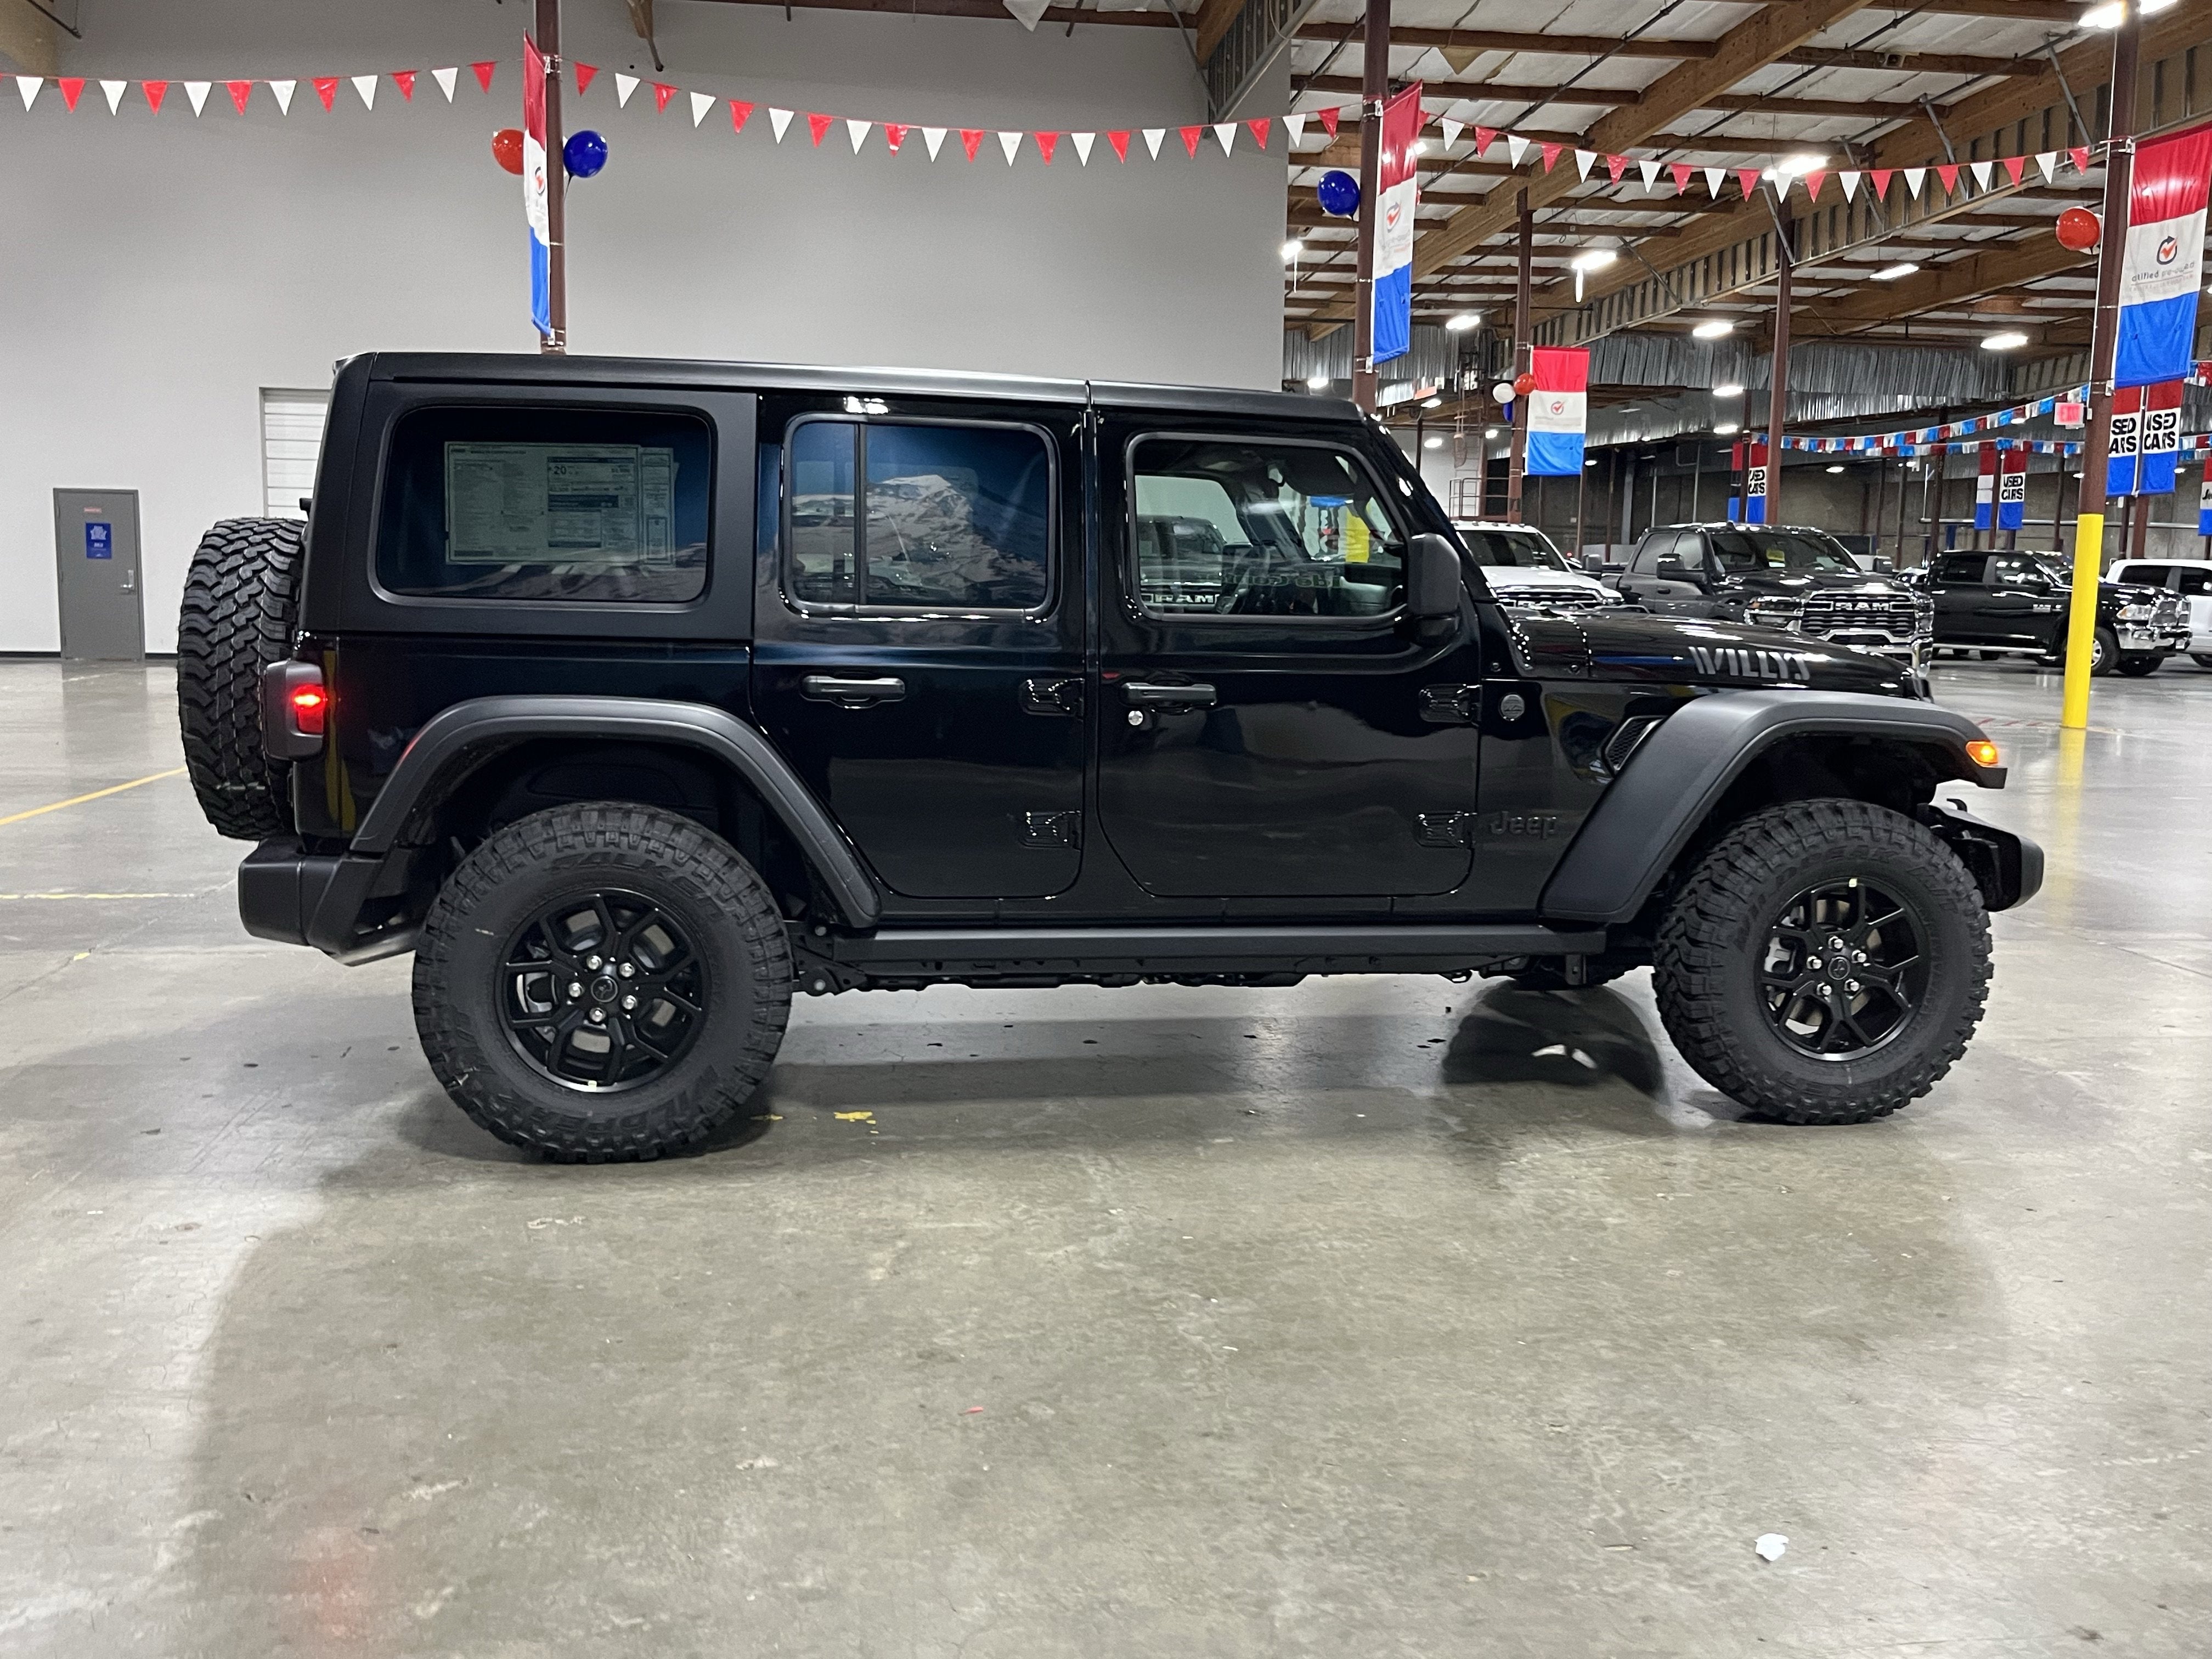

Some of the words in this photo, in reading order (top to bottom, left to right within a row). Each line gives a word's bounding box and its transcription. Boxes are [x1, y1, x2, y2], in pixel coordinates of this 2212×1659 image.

[2111, 417, 2137, 435] SED
[2109, 436, 2137, 454] ARS
[554, 465, 566, 475] 20
[2003, 475, 2023, 488] USED
[1155, 594, 1214, 603] RAM
[1835, 602, 1889, 611] RAM
[1688, 646, 1810, 680] WILLYS
[1491, 810, 1556, 840] Jeep
